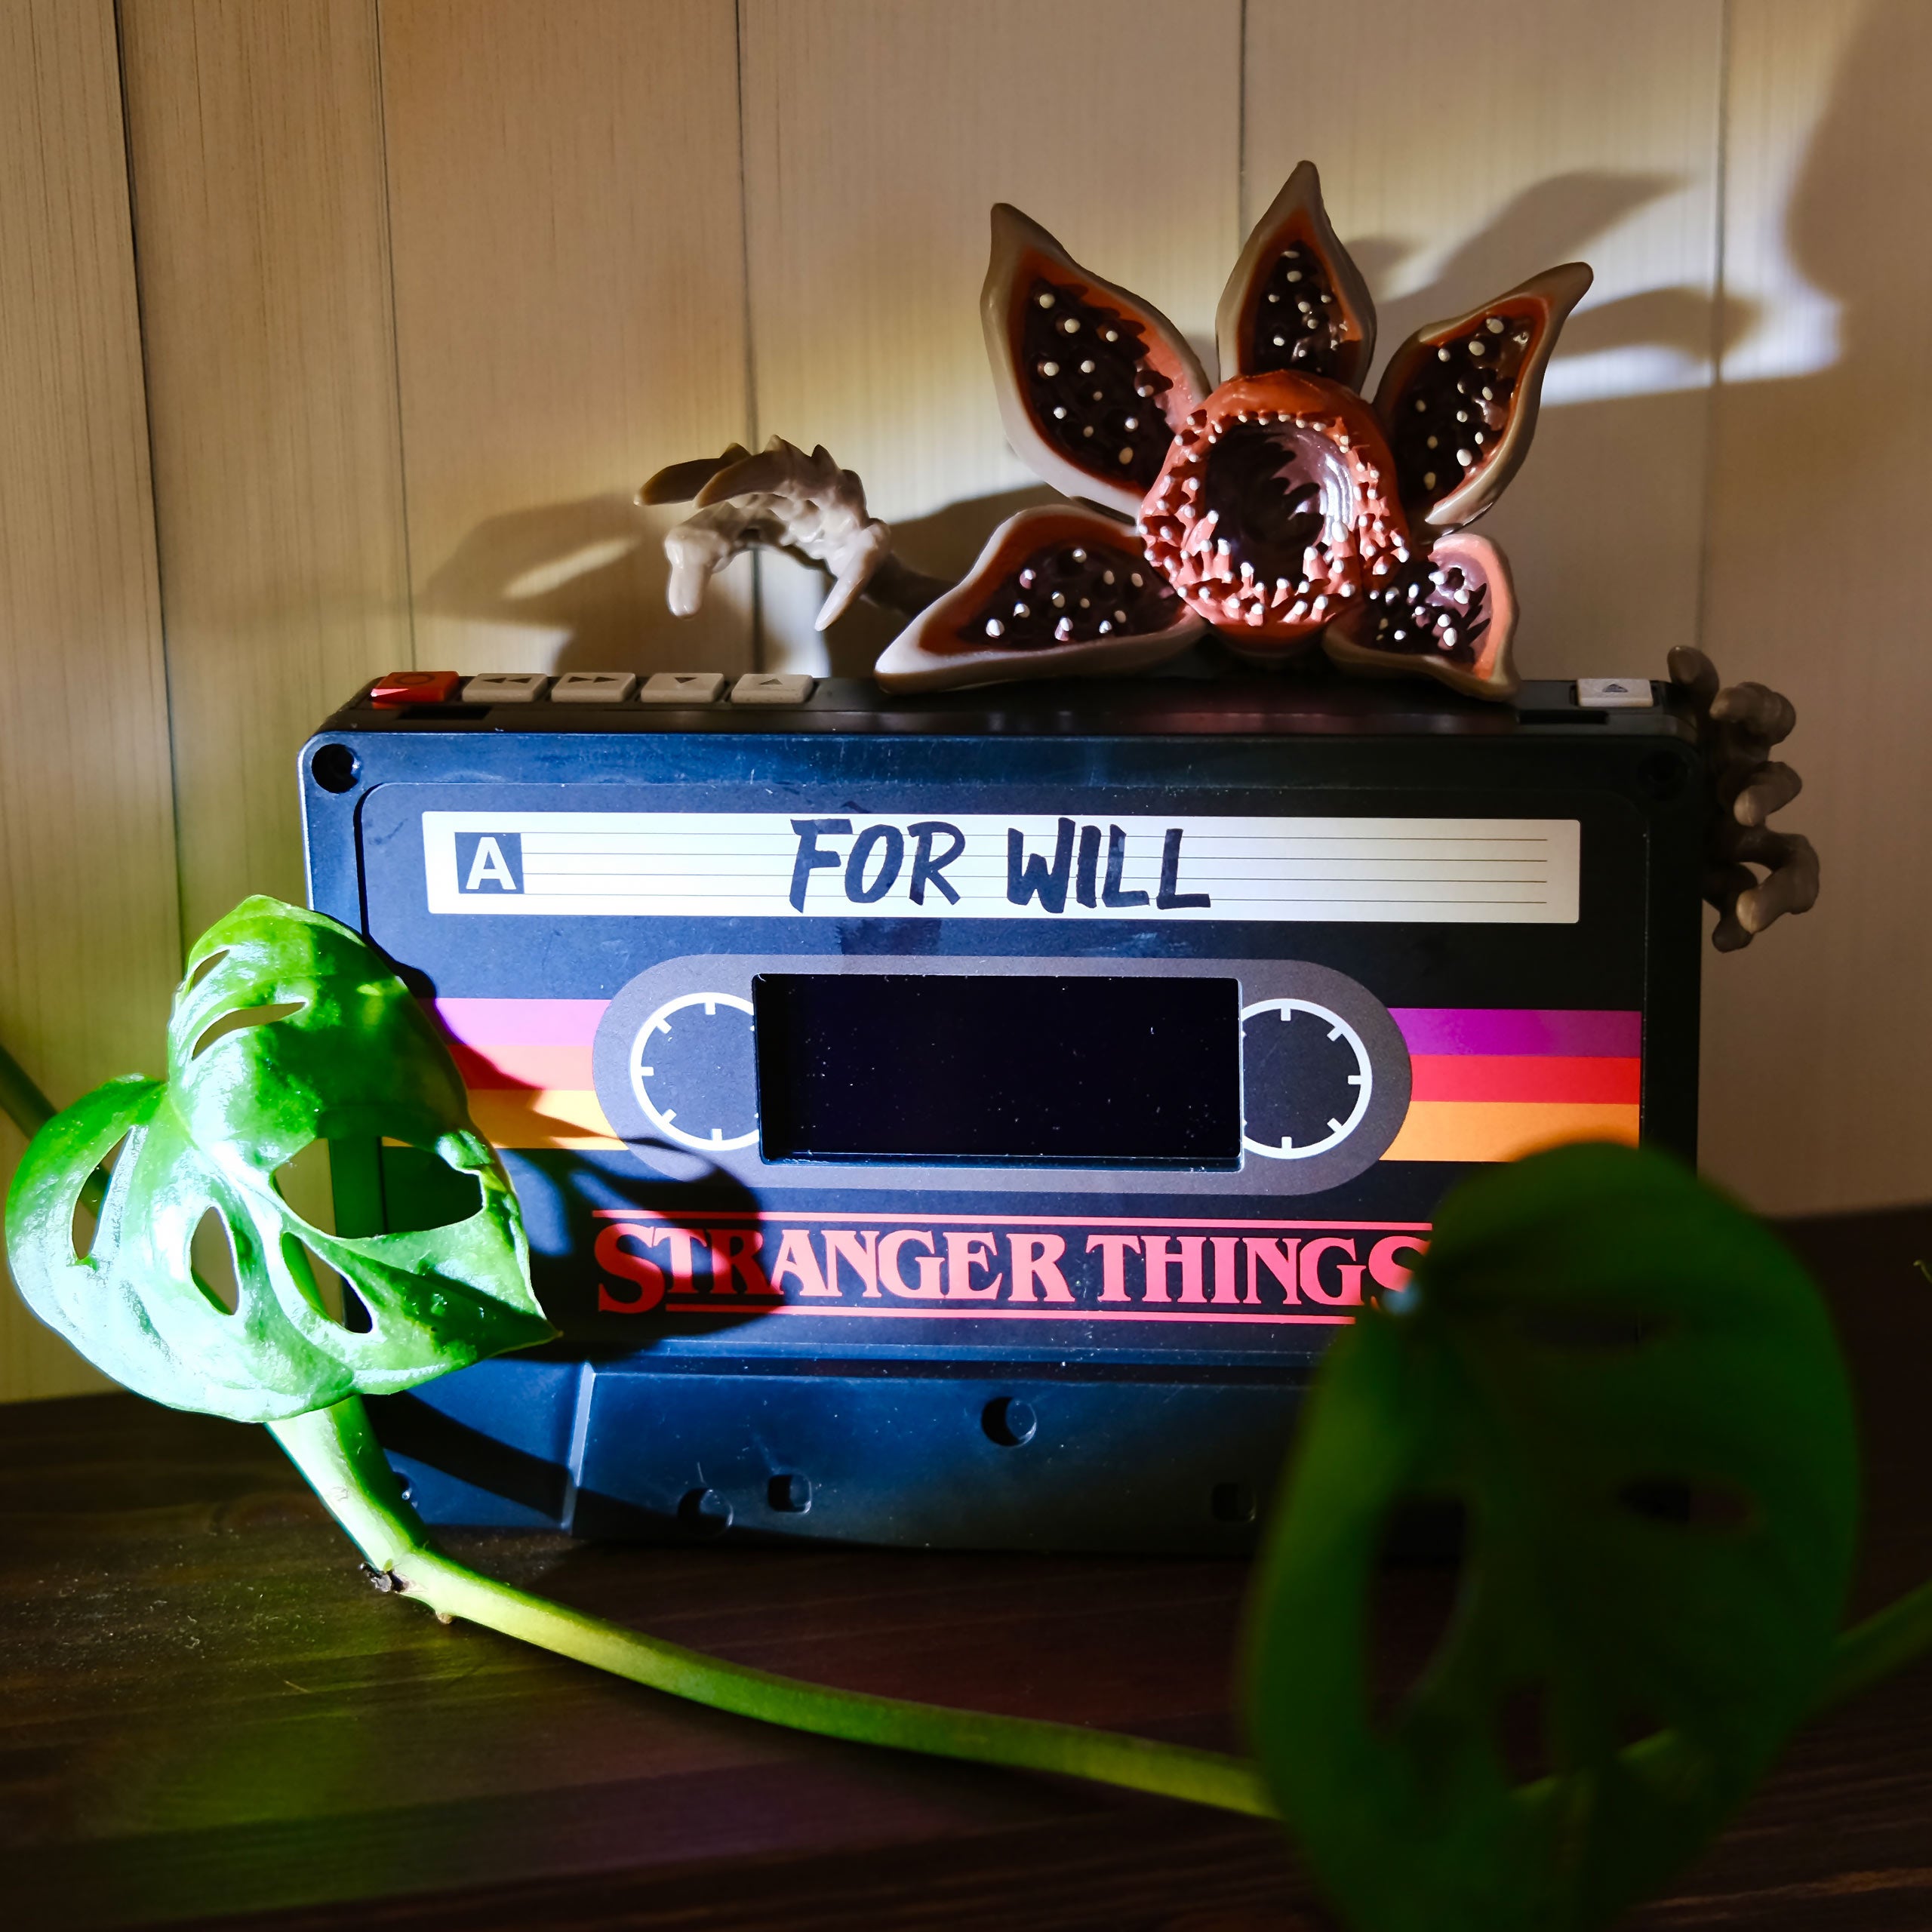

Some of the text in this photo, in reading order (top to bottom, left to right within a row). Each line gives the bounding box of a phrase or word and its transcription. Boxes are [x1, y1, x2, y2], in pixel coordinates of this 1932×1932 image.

[466, 836, 517, 891] A
[789, 817, 1211, 914] FOR WILL
[593, 1222, 1076, 1314] STRANGER
